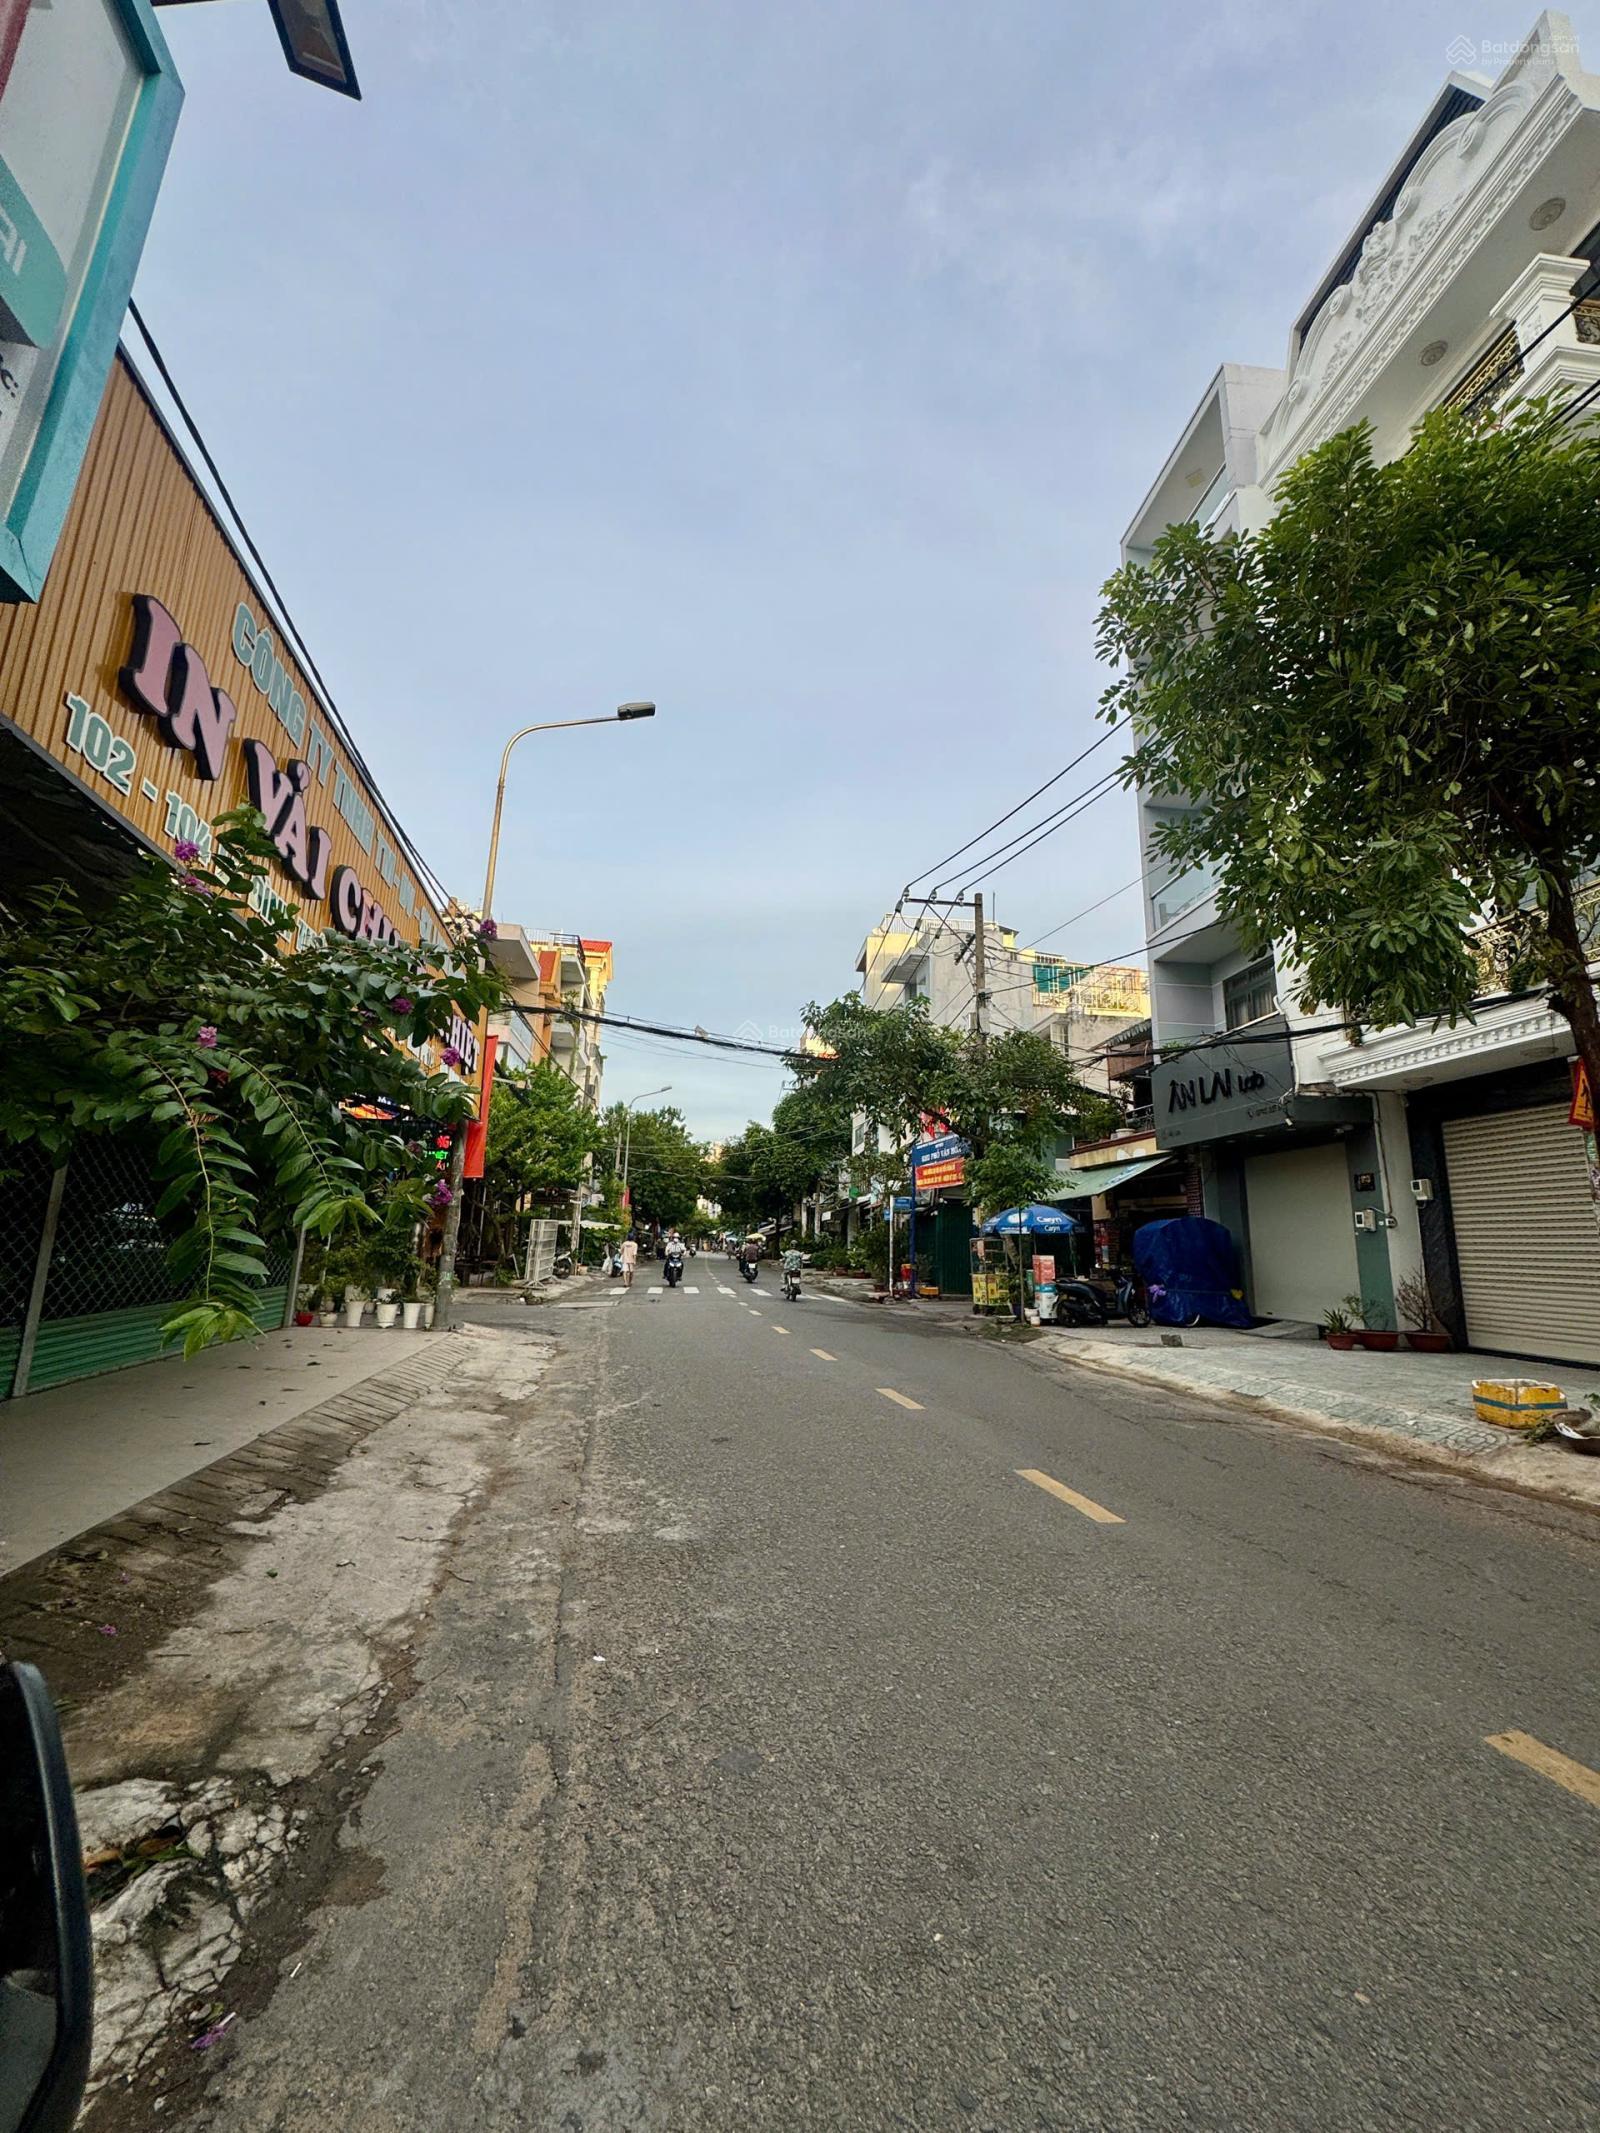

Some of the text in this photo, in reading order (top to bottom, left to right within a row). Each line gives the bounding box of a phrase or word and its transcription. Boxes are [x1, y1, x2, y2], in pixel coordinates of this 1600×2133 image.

[66, 691, 137, 797] 102
[164, 790, 213, 867] 104
[119, 593, 237, 781] IN
[244, 738, 332, 900] VẢI
[232, 601, 307, 749] CÔNG
[307, 718, 335, 788] TY
